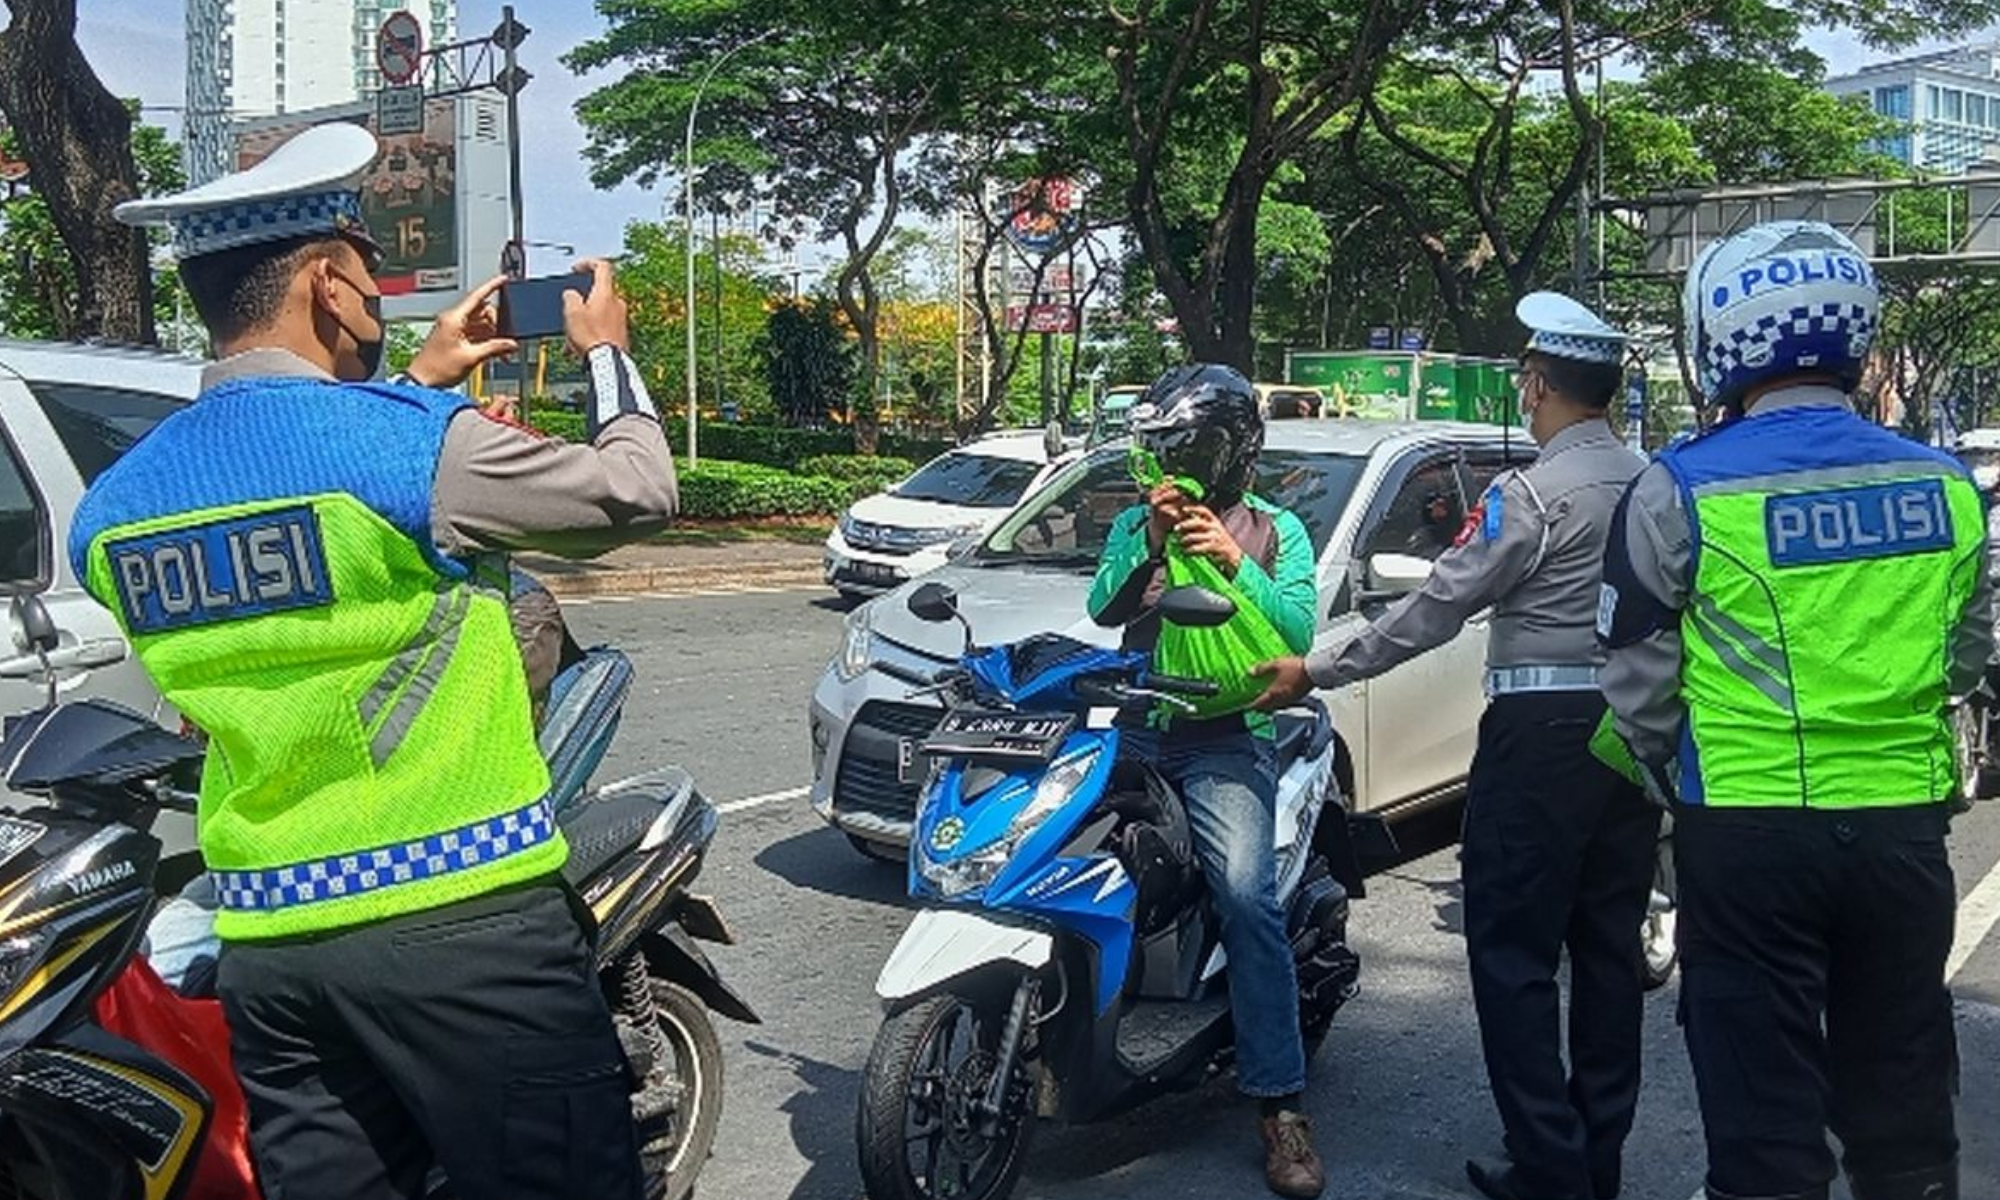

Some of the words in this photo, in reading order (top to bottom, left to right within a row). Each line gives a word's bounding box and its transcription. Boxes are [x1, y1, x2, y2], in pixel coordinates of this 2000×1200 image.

[396, 217, 427, 258] 15
[1739, 255, 1868, 296] POLISI
[1773, 490, 1947, 553] POLISI
[118, 522, 316, 622] POLISI
[66, 861, 136, 895] YAMAHA
